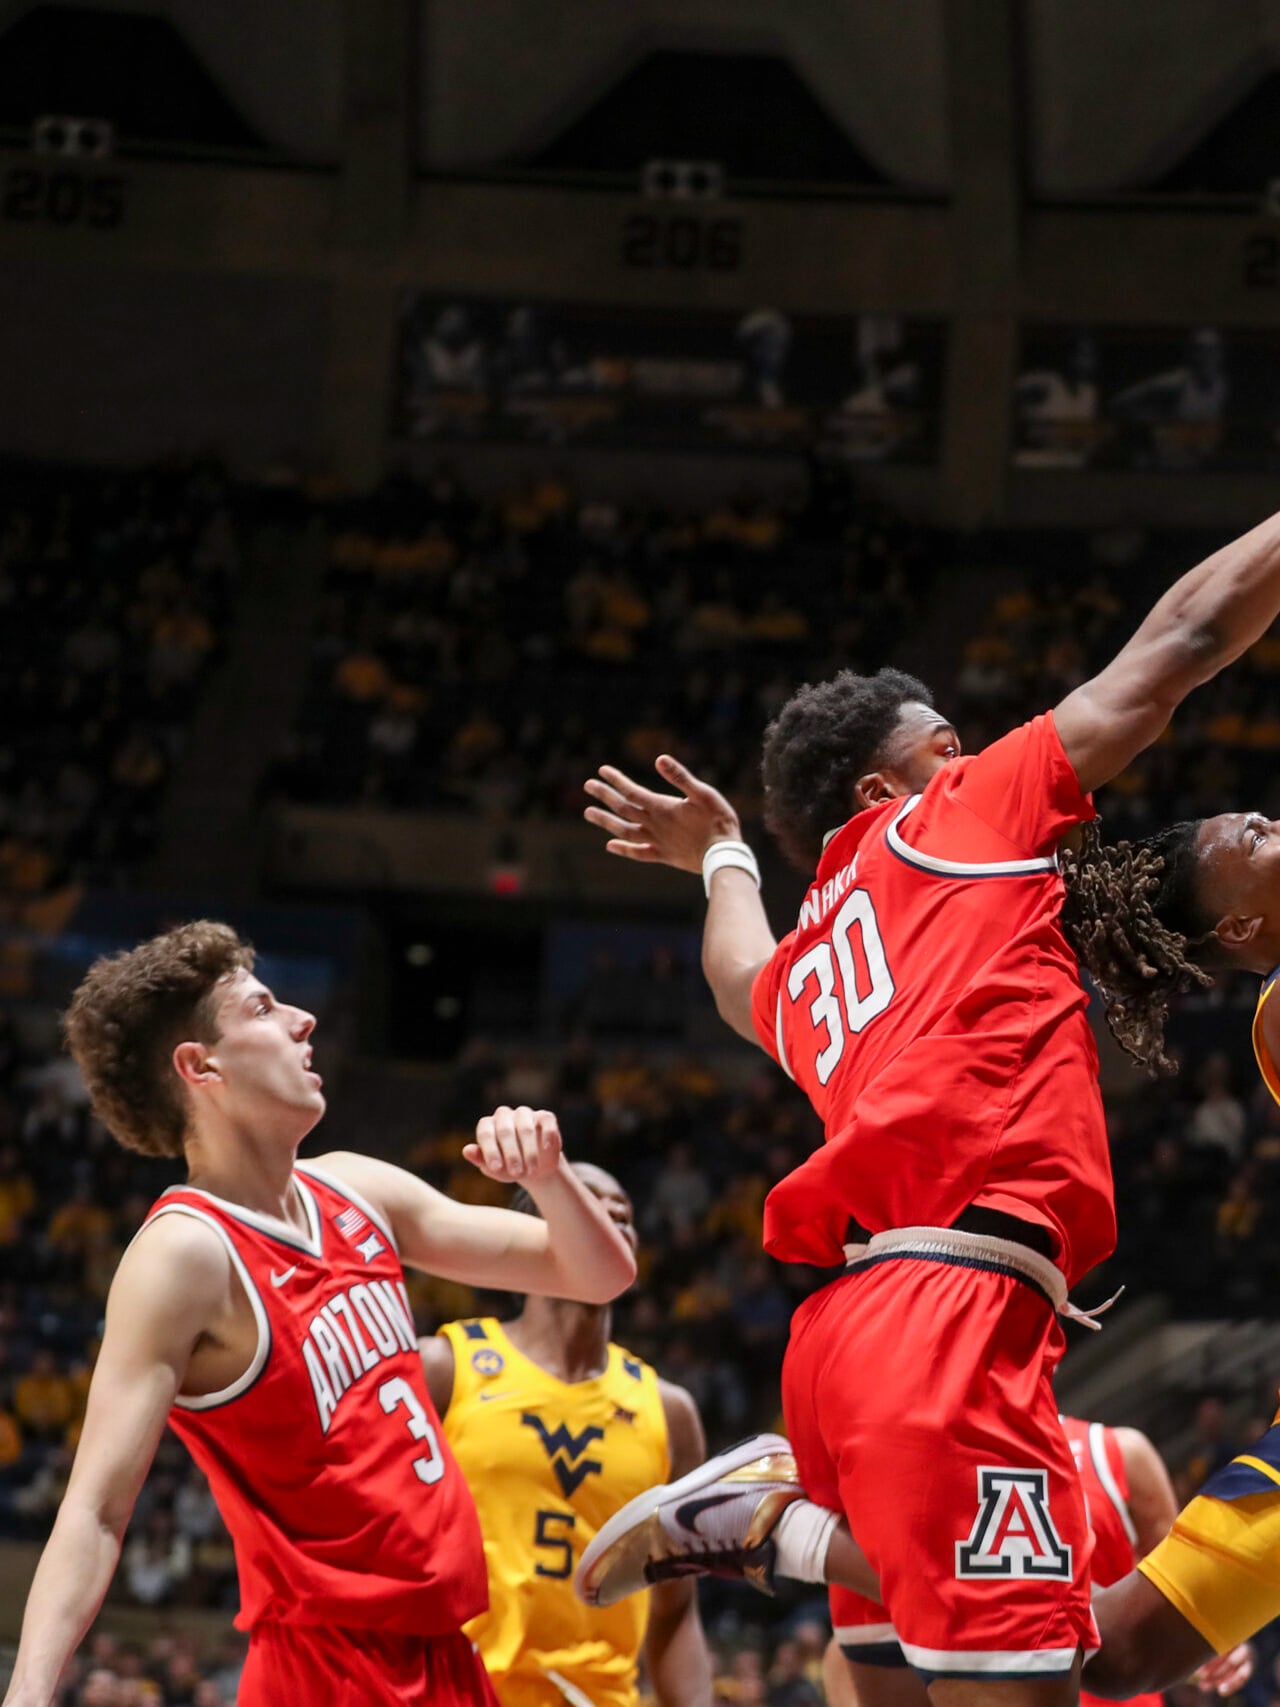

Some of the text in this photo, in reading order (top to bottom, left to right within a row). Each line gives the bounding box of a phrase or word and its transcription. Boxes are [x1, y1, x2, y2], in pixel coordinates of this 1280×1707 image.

[5, 169, 124, 228] 205
[624, 214, 740, 271] 206
[786, 887, 897, 1087] 30
[377, 1376, 445, 1485] 3
[534, 1510, 575, 1579] 5
[955, 1465, 1074, 1584] A
